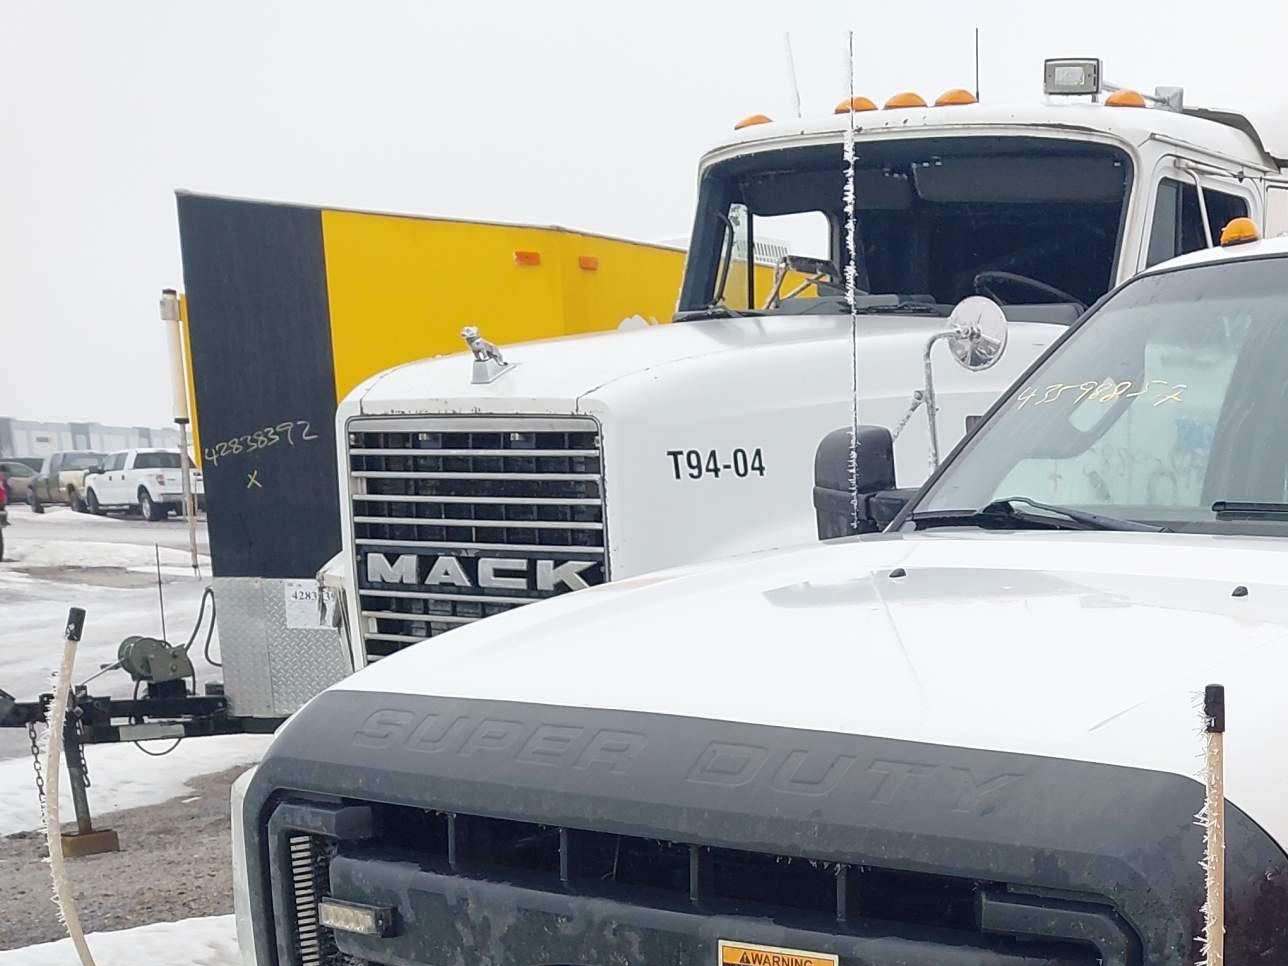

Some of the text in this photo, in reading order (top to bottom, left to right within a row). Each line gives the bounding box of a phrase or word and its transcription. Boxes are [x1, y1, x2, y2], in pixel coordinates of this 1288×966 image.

[204, 421, 319, 467] 42838392
[667, 448, 766, 480] T94-04
[366, 552, 600, 591] MACK
[352, 706, 1026, 816] SUPER DUTY
